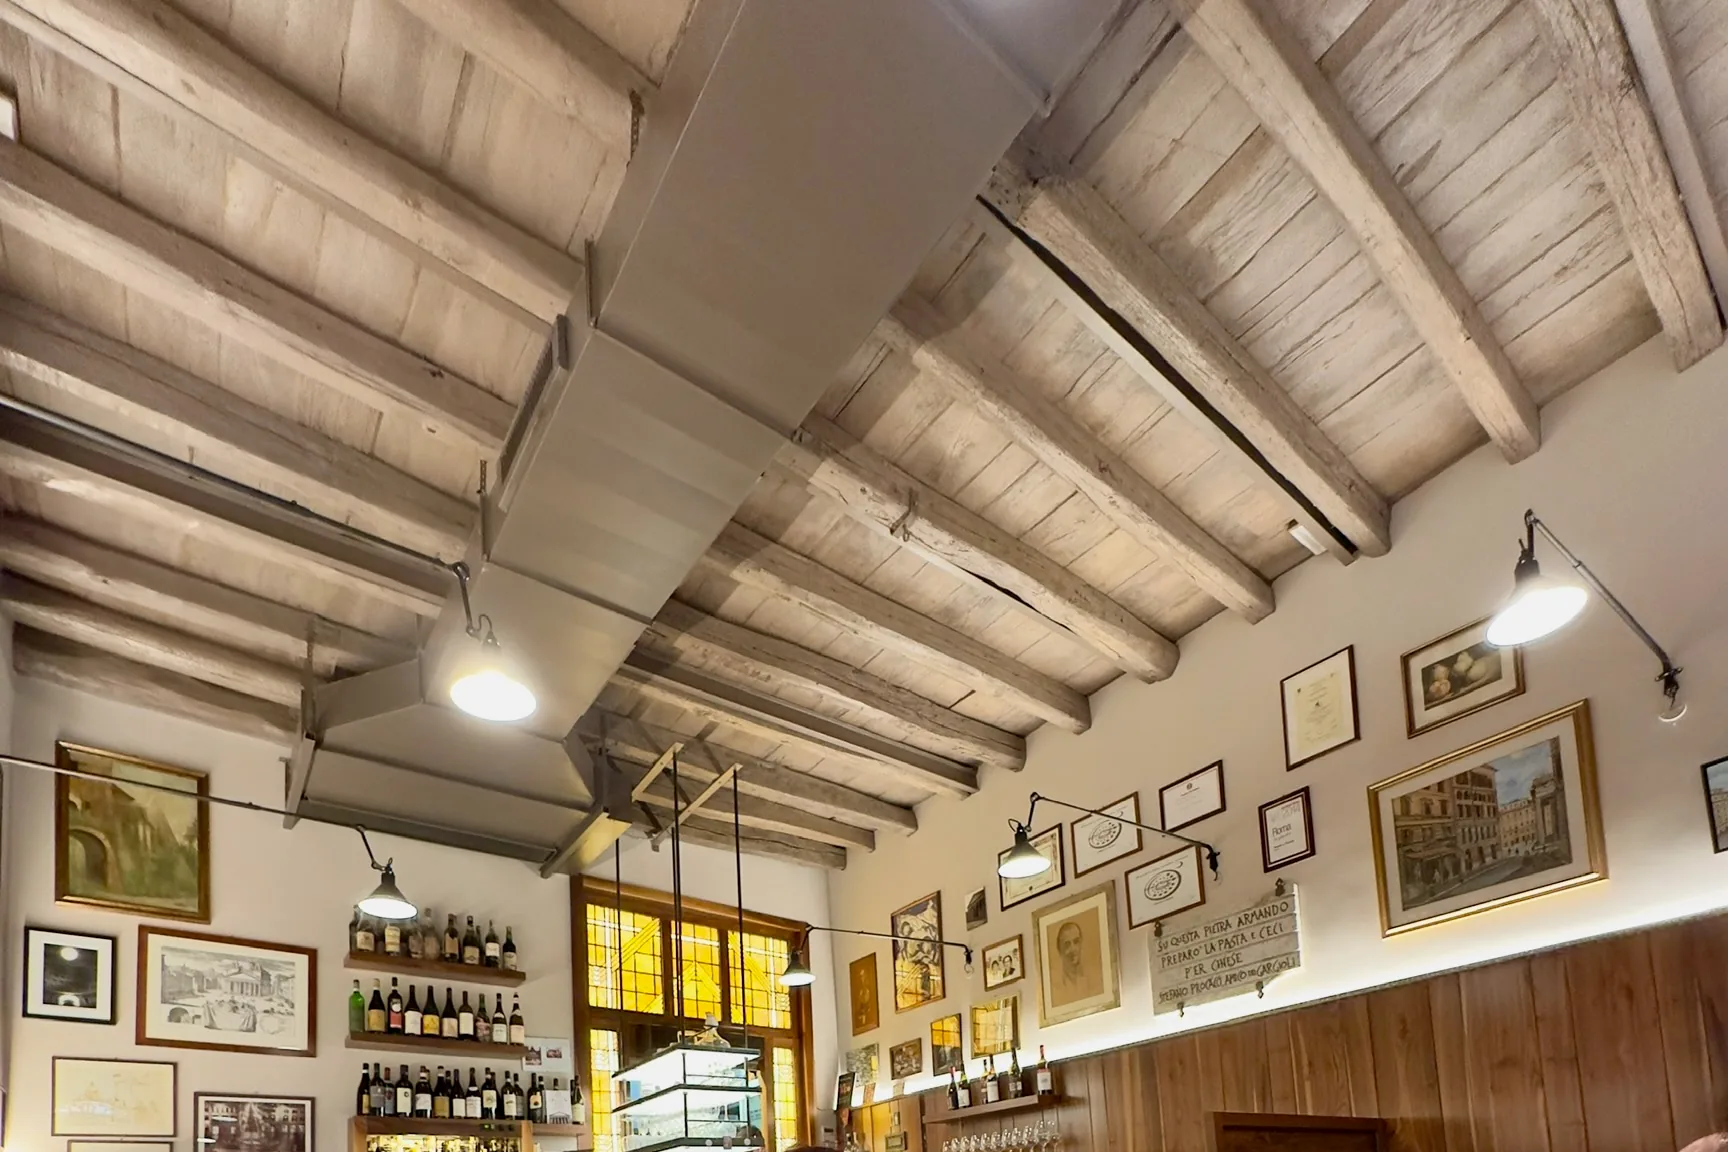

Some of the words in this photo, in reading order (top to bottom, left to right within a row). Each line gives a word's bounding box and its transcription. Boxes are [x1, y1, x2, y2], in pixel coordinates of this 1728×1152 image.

[1272, 823, 1292, 837] Roma
[1157, 940, 1169, 953] SU
[1170, 930, 1200, 946] QUESTA
[1204, 919, 1232, 937] PIETRA
[1237, 901, 1289, 928] ARMANDO
[1204, 942, 1216, 955] LA
[1218, 933, 1248, 951] PASTA
[1259, 922, 1284, 939] CECI
